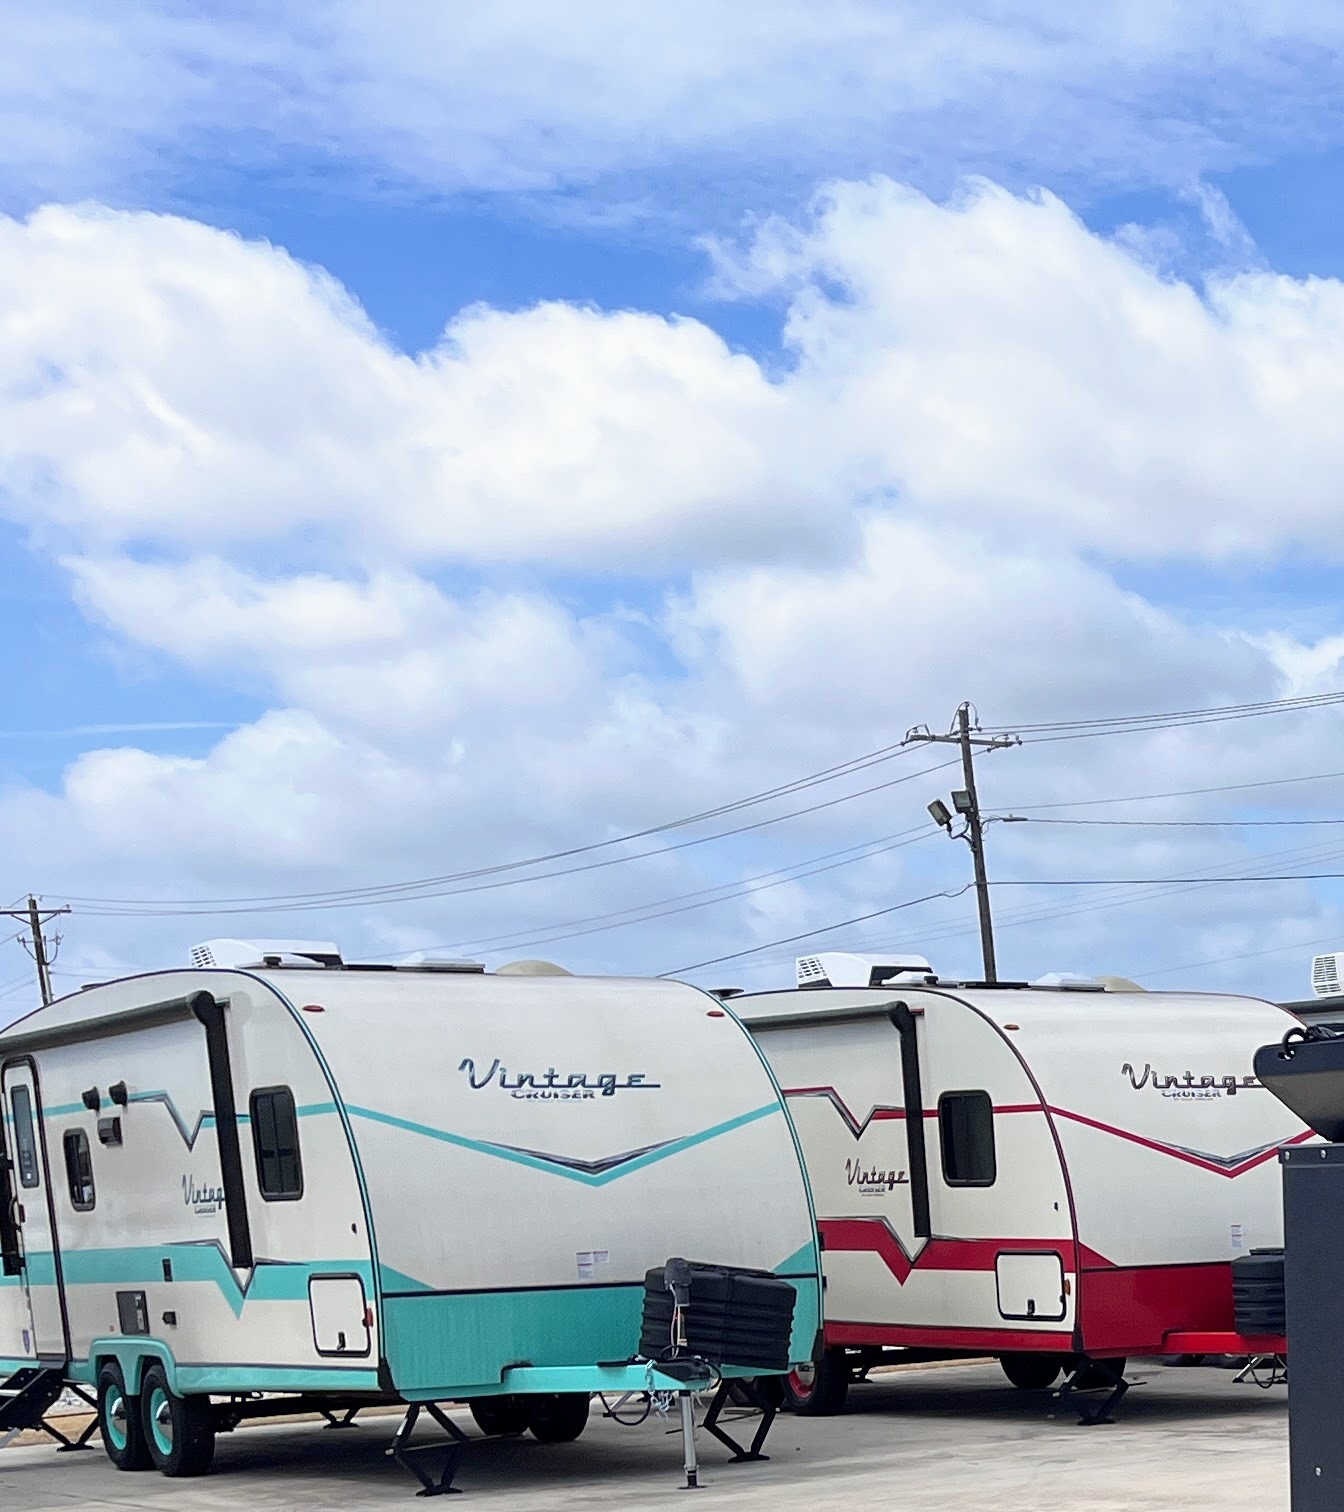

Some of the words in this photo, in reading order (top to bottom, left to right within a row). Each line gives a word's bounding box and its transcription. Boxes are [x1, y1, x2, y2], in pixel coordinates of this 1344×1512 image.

[457, 1058, 661, 1097] Vintage
[510, 1089, 595, 1100] CRUISER
[1120, 1062, 1267, 1096] Vintage
[844, 1157, 910, 1191] Vintage
[182, 1173, 226, 1210] Vintag
